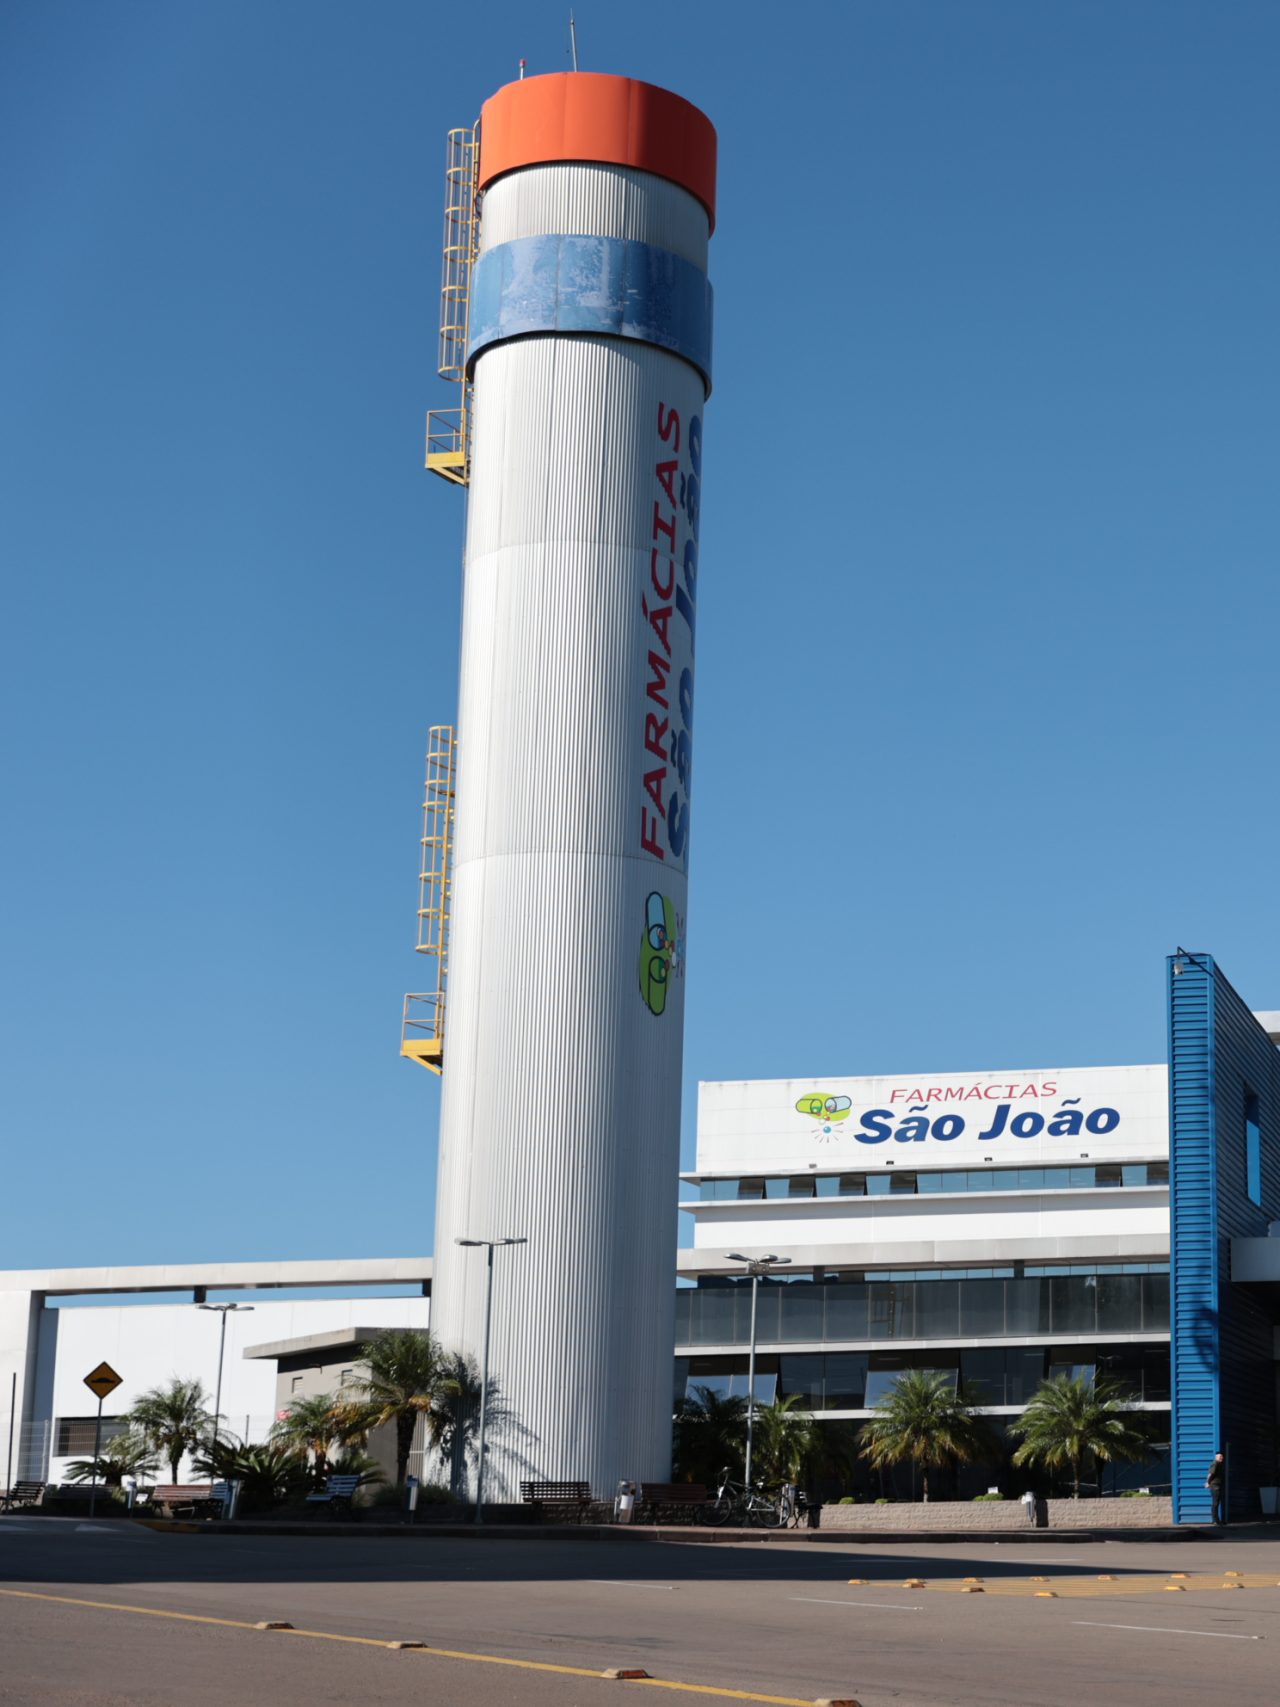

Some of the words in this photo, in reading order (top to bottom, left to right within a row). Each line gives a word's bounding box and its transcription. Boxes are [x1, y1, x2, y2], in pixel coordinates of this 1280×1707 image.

[641, 402, 681, 860] FARMÁCIAS
[890, 1081, 1058, 1103] FARMÁCIAS
[854, 1105, 965, 1144] São
[978, 1098, 1121, 1140] João
